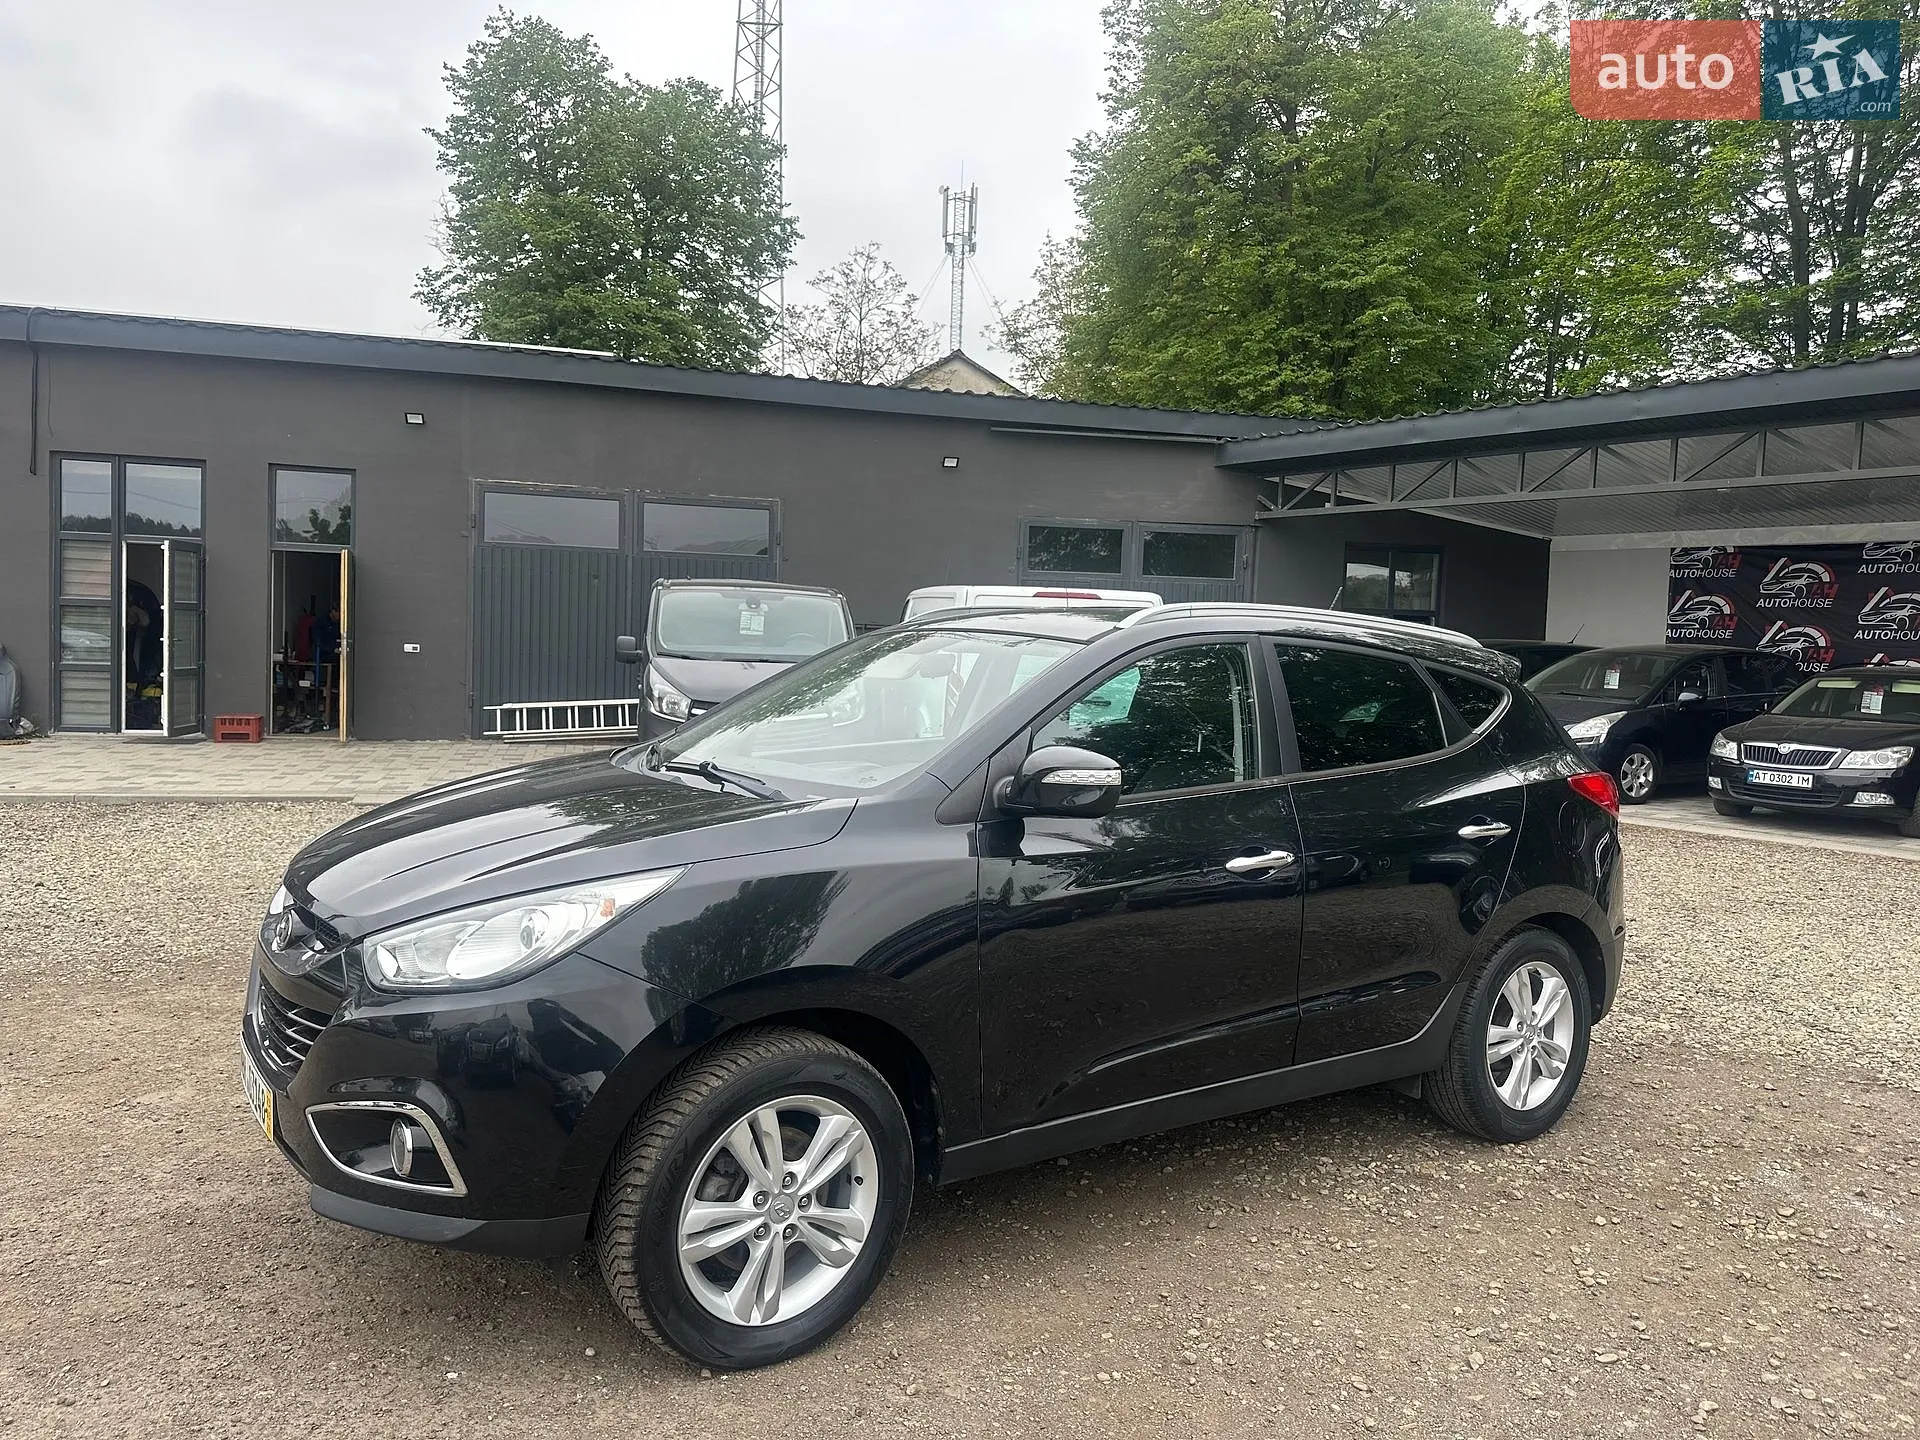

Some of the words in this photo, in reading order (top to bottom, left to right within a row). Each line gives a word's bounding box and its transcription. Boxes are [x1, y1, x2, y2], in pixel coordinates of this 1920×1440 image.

[1669, 568, 1737, 578] AUTOHOUSE
[1756, 598, 1834, 608] AUTOHOUSE
[1665, 628, 1734, 639] AUTOHOUSE
[1754, 771, 1768, 782] AT
[1769, 773, 1793, 785] 0302
[1797, 775, 1810, 786] IM
